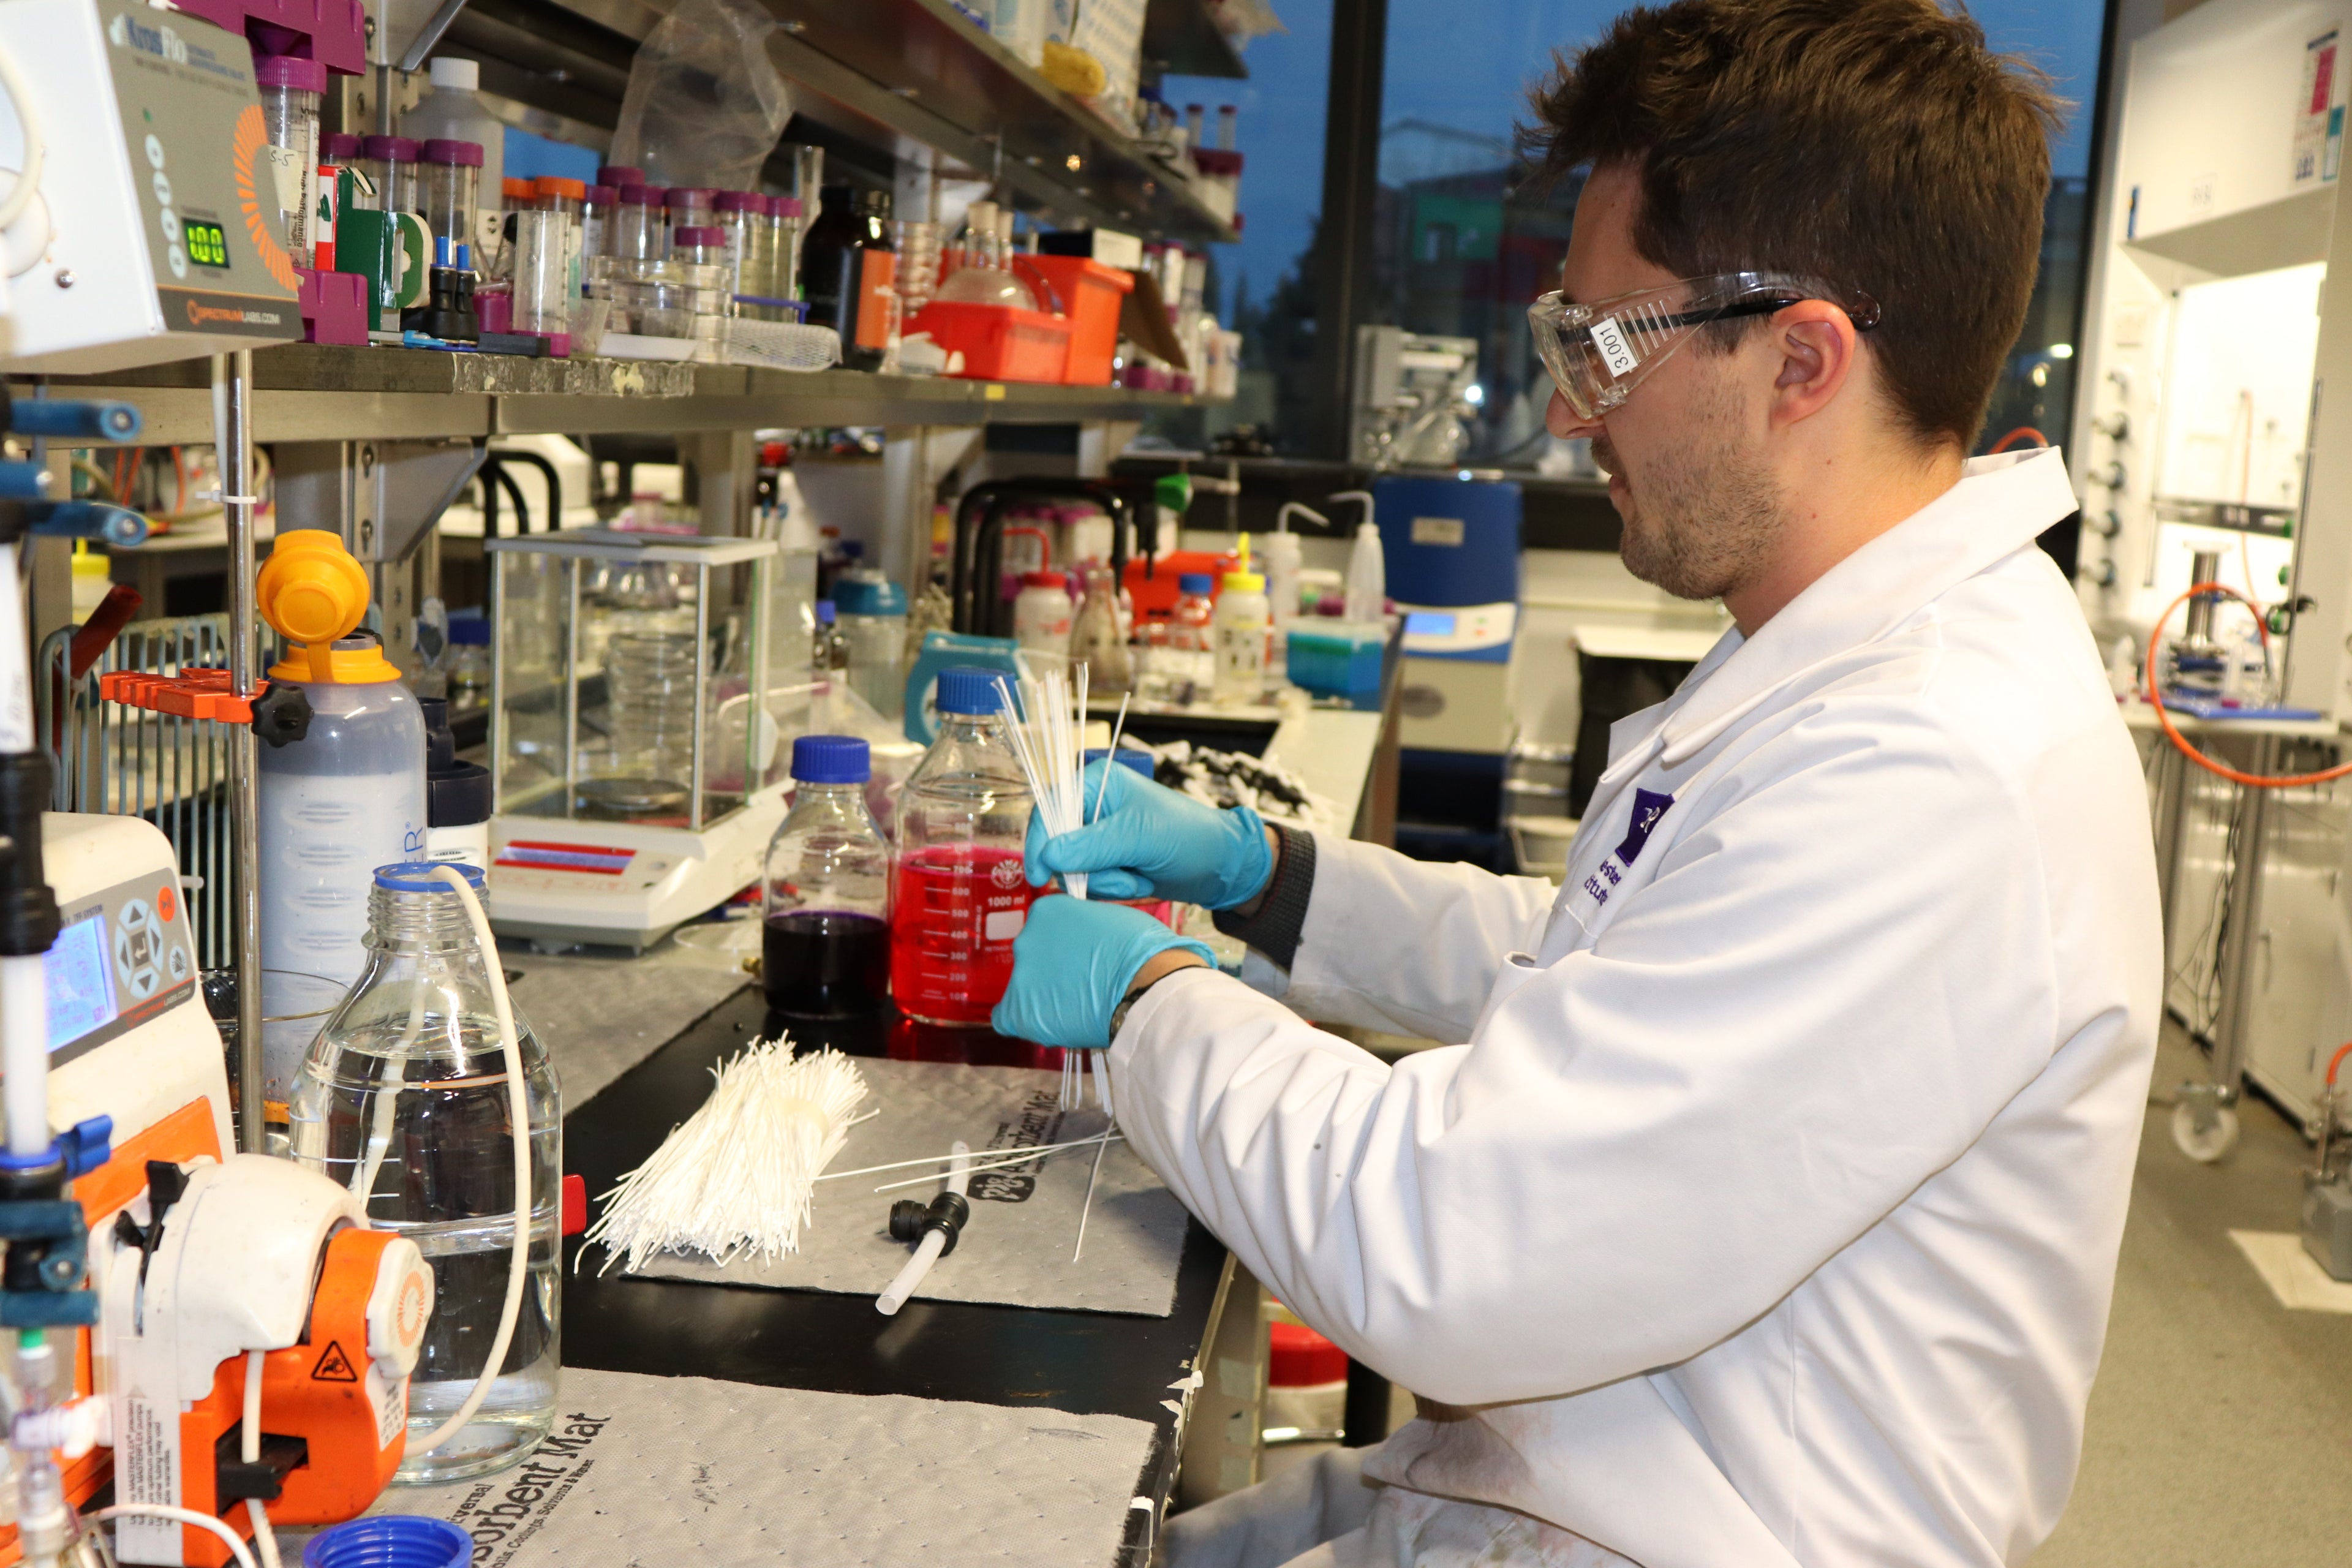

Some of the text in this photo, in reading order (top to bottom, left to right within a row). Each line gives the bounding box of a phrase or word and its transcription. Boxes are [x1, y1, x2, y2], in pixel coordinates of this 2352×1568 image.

[187, 226, 225, 264] 100
[1599, 327, 1629, 369] 3.001
[987, 896, 1012, 907] 1000
[951, 910, 969, 918] 500
[951, 930, 968, 939] 400
